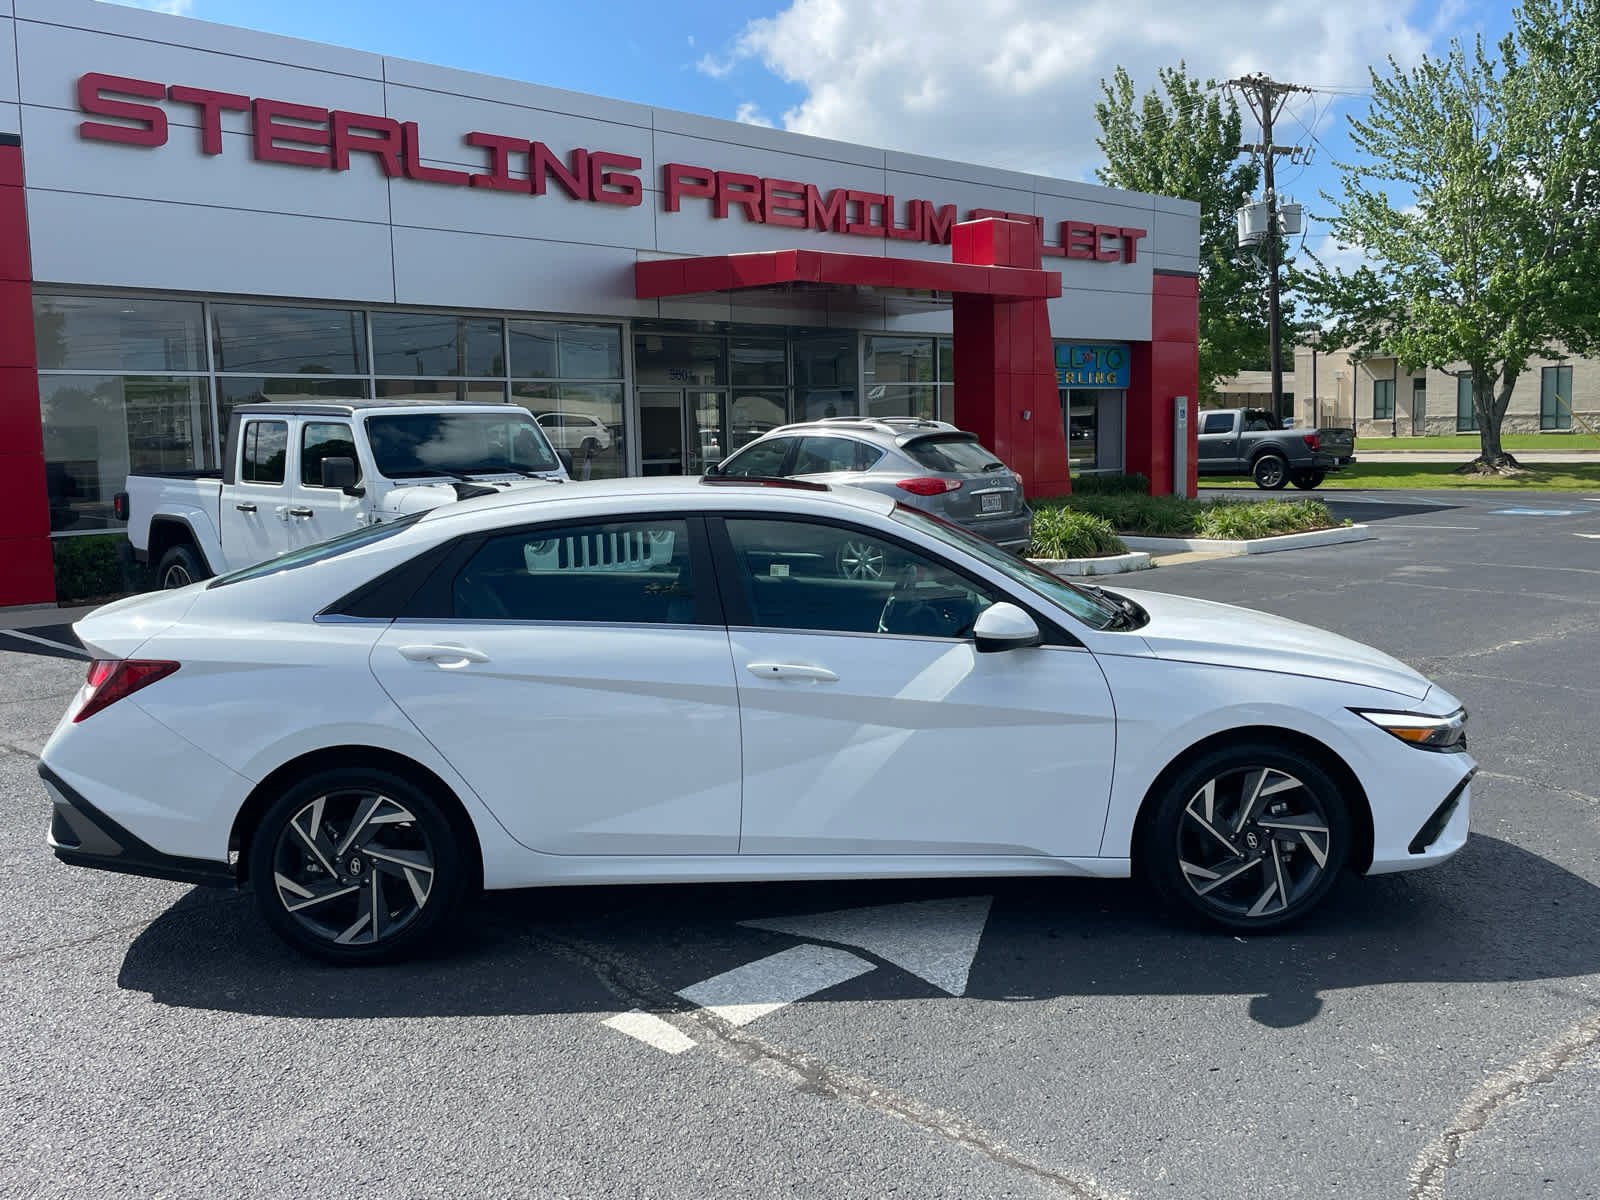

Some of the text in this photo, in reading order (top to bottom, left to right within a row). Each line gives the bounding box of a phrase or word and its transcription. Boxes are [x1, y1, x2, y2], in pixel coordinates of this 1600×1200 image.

[78, 72, 1148, 264] STERLING PREMIUM LECT
[1055, 371, 1117, 385] ERLING
